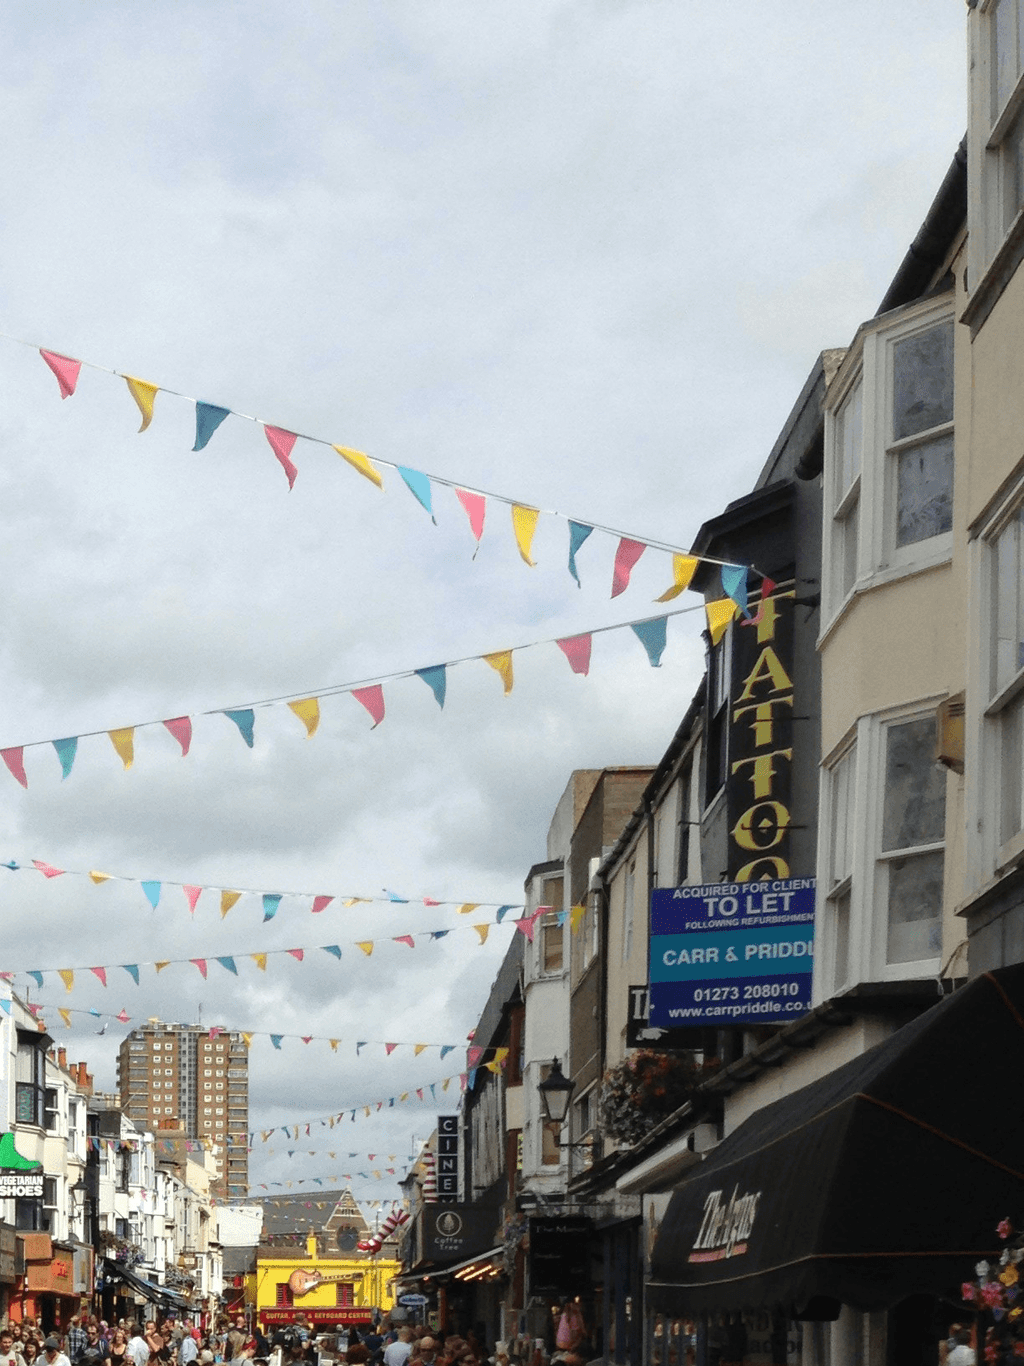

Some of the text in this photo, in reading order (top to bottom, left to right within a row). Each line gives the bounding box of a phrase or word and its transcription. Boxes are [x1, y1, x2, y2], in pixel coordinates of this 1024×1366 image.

[672, 878, 816, 899] ACQUIRED FOR CLIENT
[703, 892, 796, 918] TO LET
[685, 913, 815, 930] FOLLOWING REFURBISHMEN
[662, 947, 720, 966] CARR
[724, 945, 739, 962] &
[693, 982, 799, 1002] 01273 208010
[442, 1119, 454, 1202] CINE
